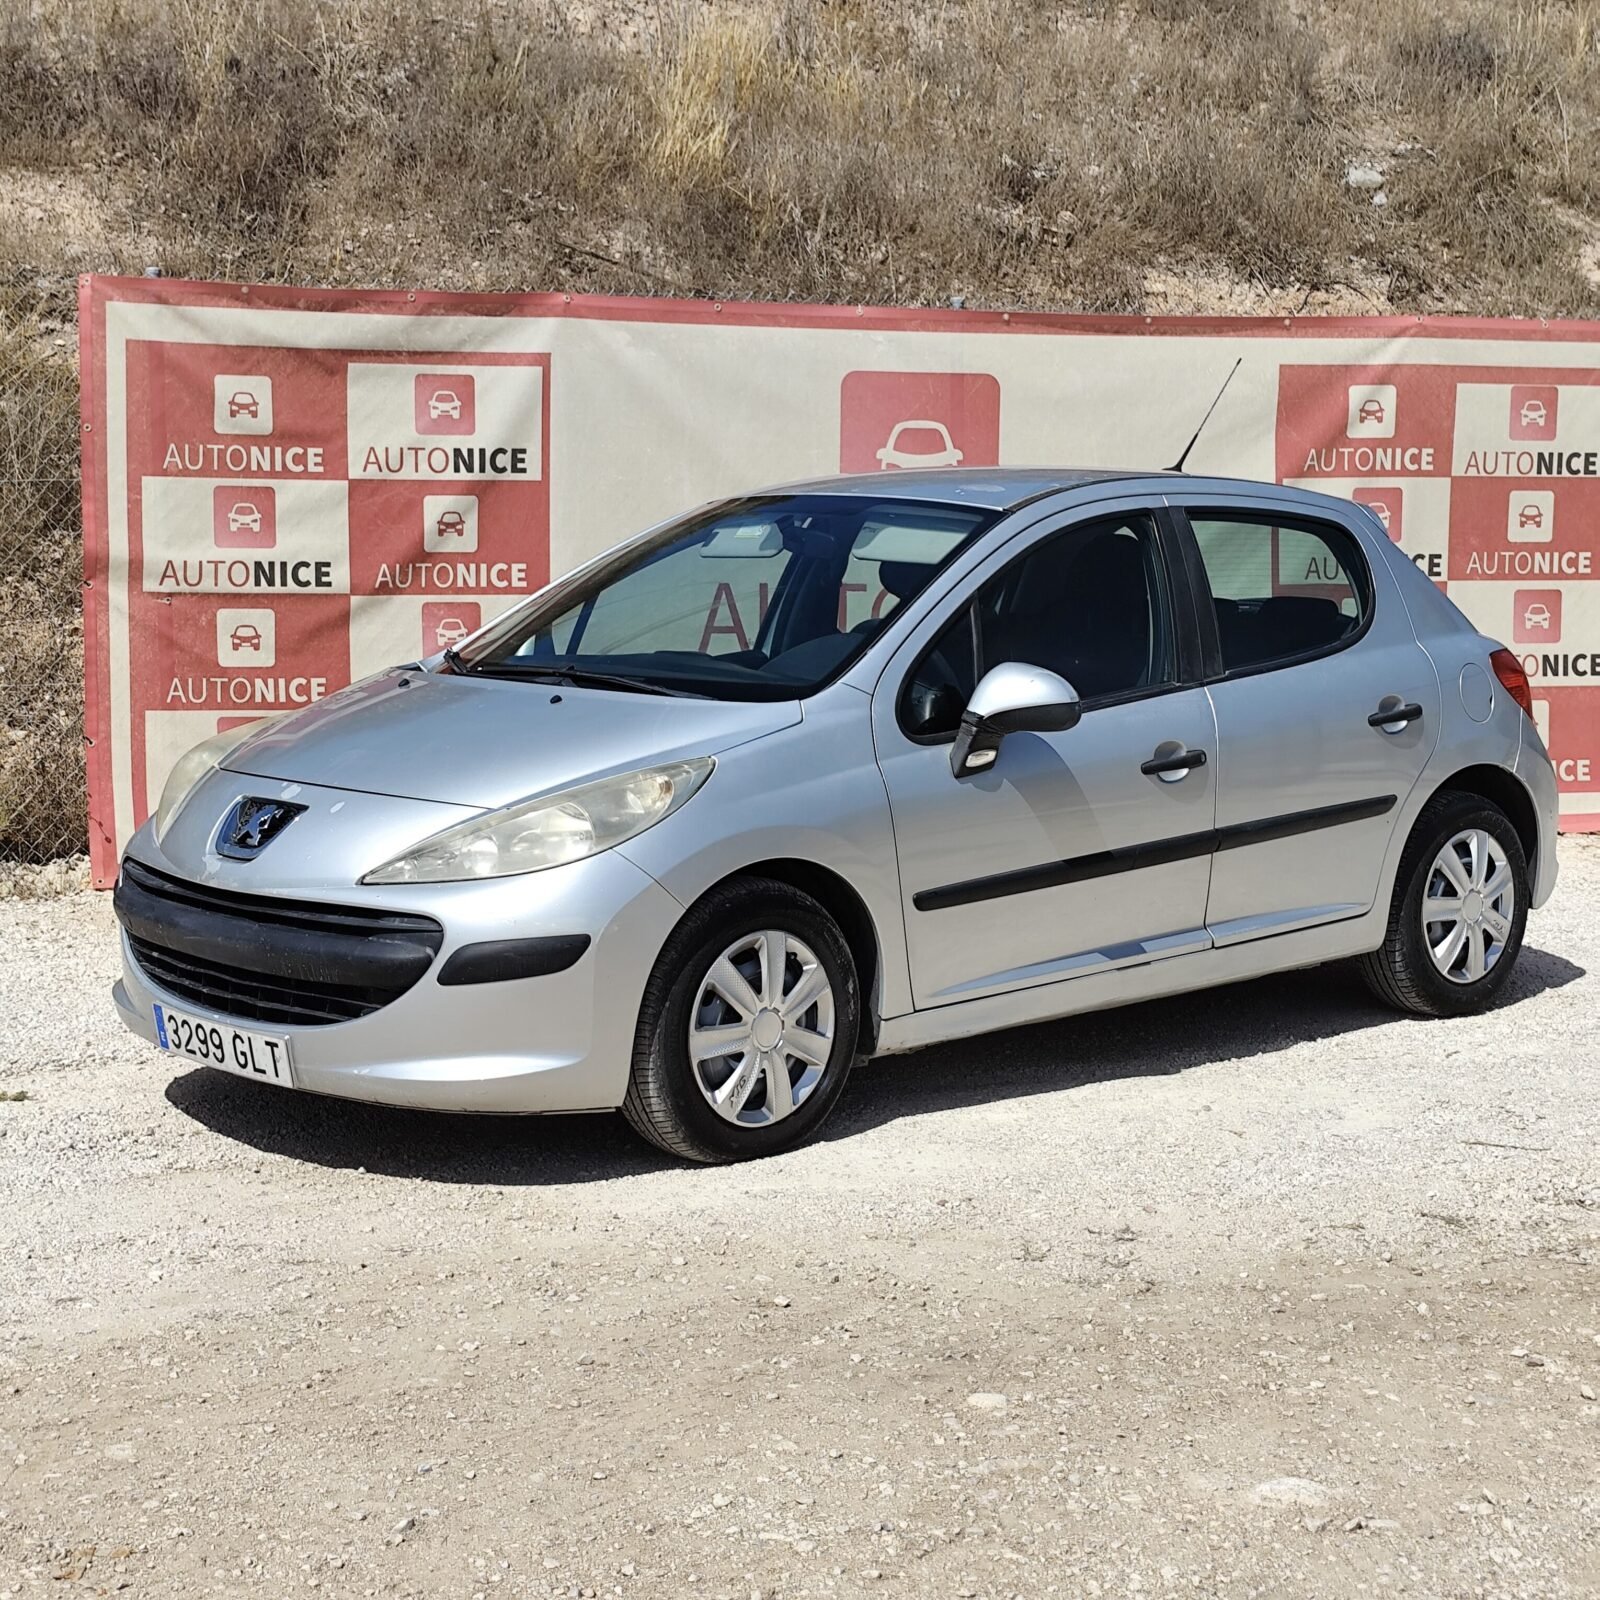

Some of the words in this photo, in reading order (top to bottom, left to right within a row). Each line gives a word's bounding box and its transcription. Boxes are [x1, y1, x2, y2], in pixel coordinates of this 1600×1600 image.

[163, 443, 325, 473] AUTONICE
[363, 446, 528, 474] AUTONICE
[1304, 447, 1435, 472] AUTONICE
[1464, 451, 1598, 475] AUTONICE
[159, 560, 332, 588] AUTONICE
[375, 562, 527, 588] AUTONICE
[1466, 551, 1592, 574] AUTONICE
[166, 677, 327, 703] AUTONICE
[168, 1014, 225, 1063] 3299
[232, 1032, 279, 1078] GLT
